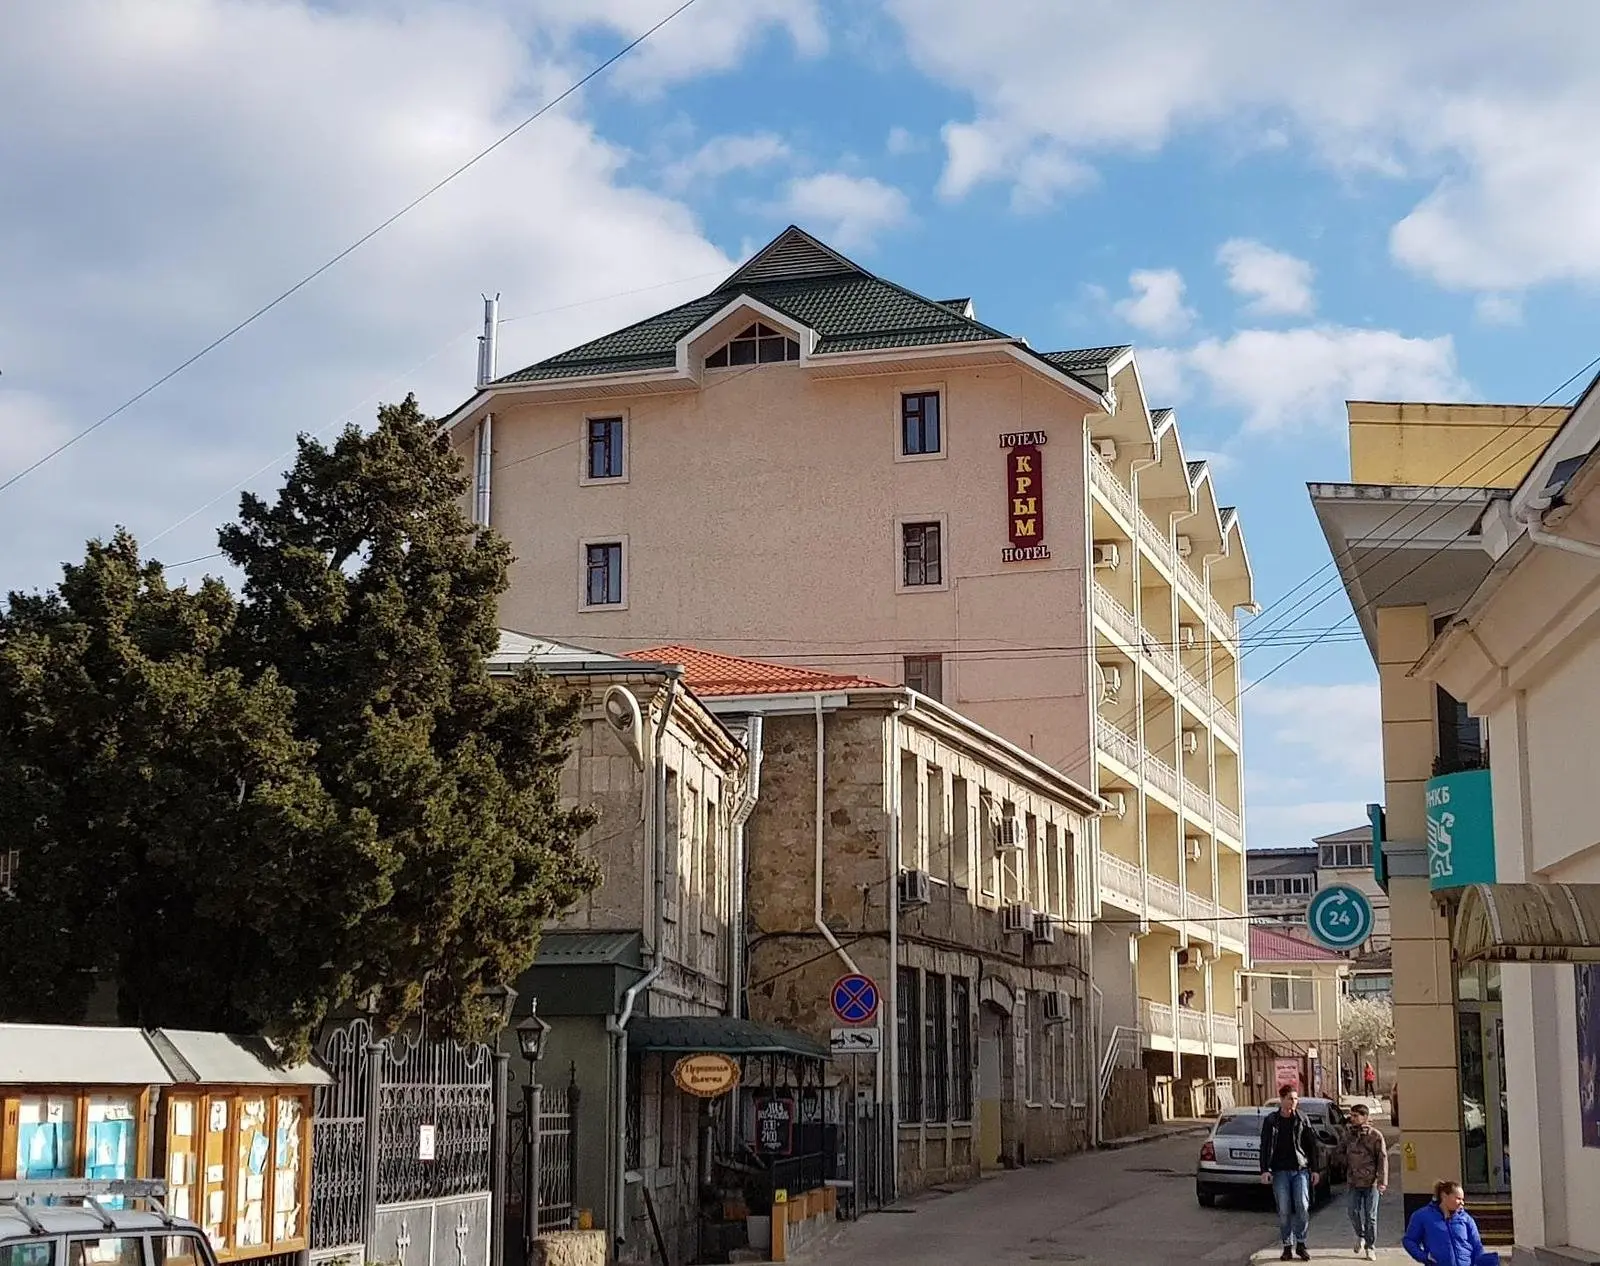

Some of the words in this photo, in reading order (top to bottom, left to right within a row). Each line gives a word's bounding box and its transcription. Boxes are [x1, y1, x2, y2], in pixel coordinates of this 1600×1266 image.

[1001, 431, 1046, 447] ГОТЕЛЬ
[1013, 455, 1037, 536] КРЫМ
[1003, 546, 1049, 561] HOTEL
[1329, 910, 1350, 925] 24
